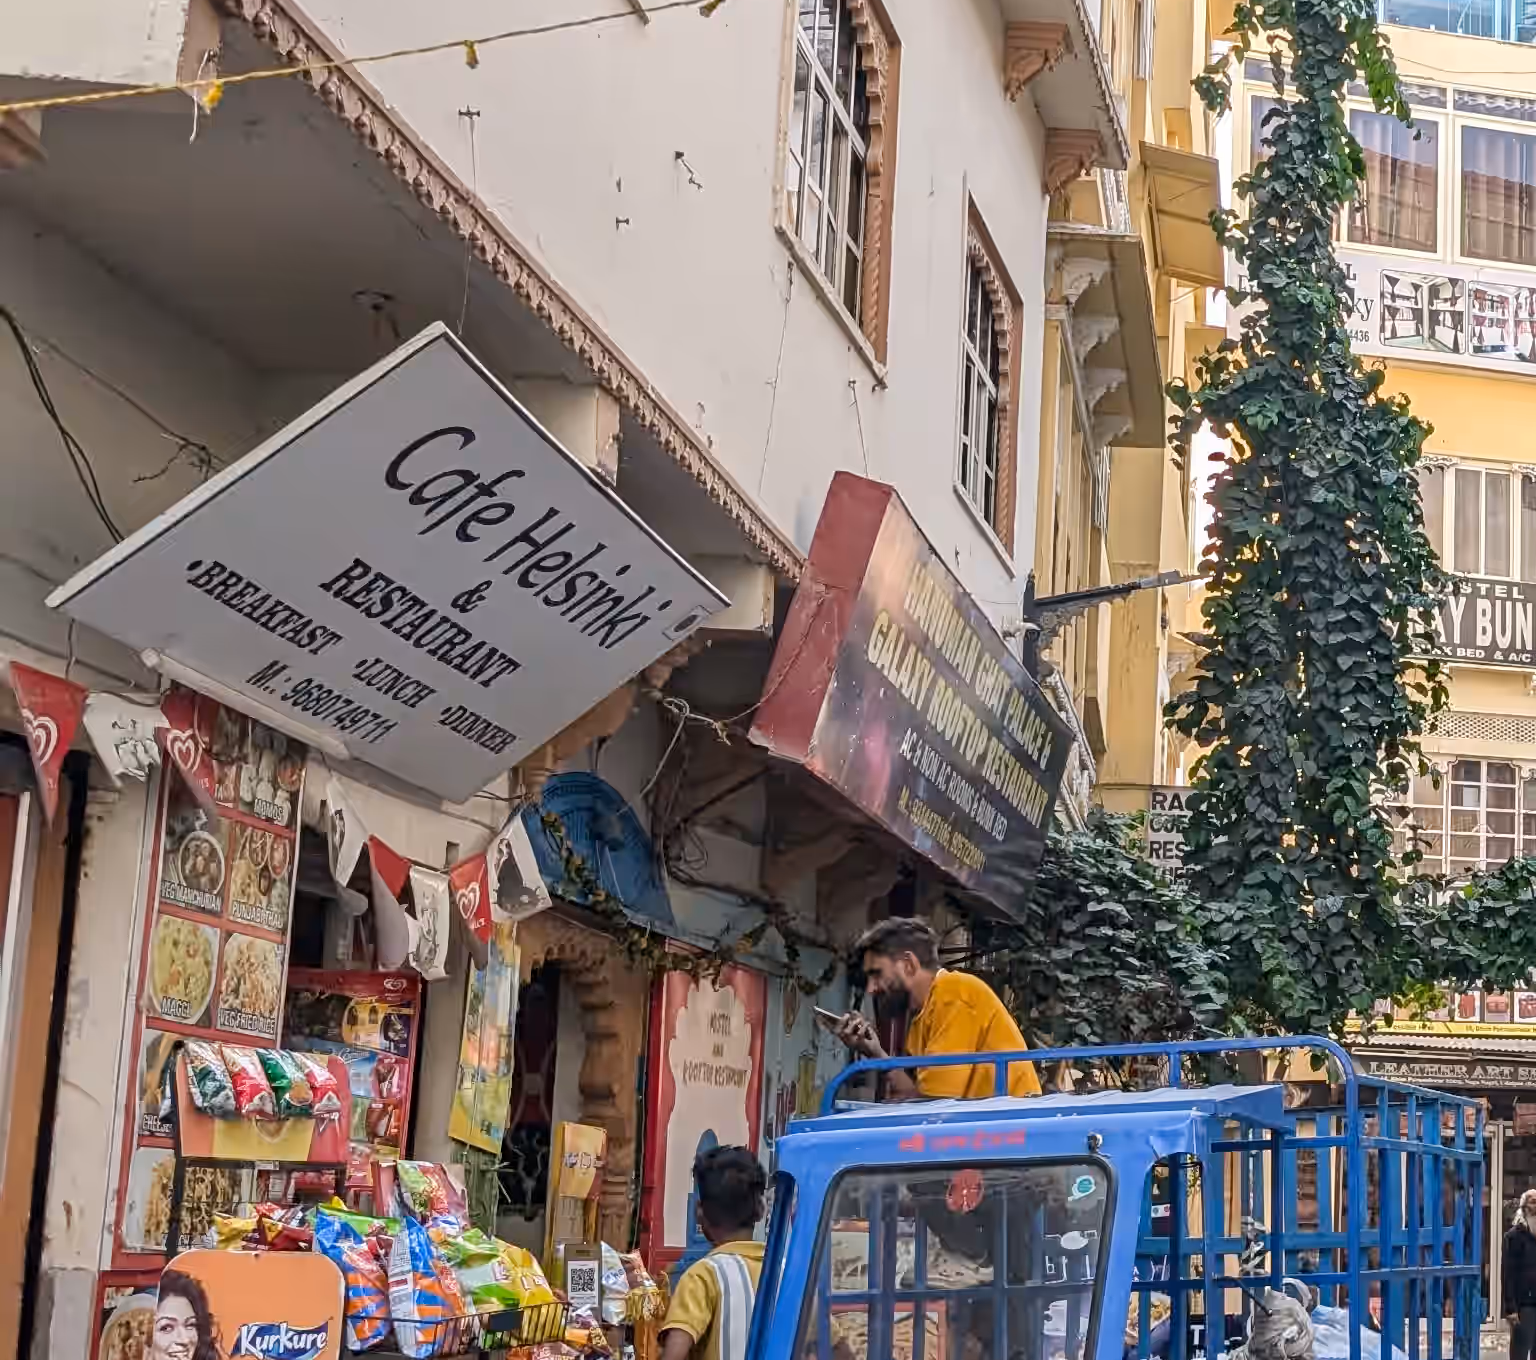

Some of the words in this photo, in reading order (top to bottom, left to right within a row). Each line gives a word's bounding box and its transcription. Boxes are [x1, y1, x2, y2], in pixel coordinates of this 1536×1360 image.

[384, 427, 524, 541] Cafe
[483, 507, 672, 650] Helsinki
[318, 557, 521, 687] RESTAURANT
[450, 580, 492, 612] &
[1456, 647, 1485, 658] BED
[1494, 651, 1504, 660] &
[1508, 652, 1532, 662] A/C
[281, 677, 398, 743] 9680749711
[867, 609, 936, 711] GALAXY
[926, 675, 989, 767] ROOFTOP
[982, 736, 1049, 829] RESTAURANT
[1004, 687, 1048, 761] PALACE
[900, 727, 917, 760] AC
[920, 745, 941, 783] NON
[936, 762, 951, 791] AC
[947, 771, 976, 813] ROOMS
[1369, 1061, 1469, 1078] LEATHER
[1472, 1065, 1514, 1080] ART
[240, 1323, 327, 1360] Kurkure
